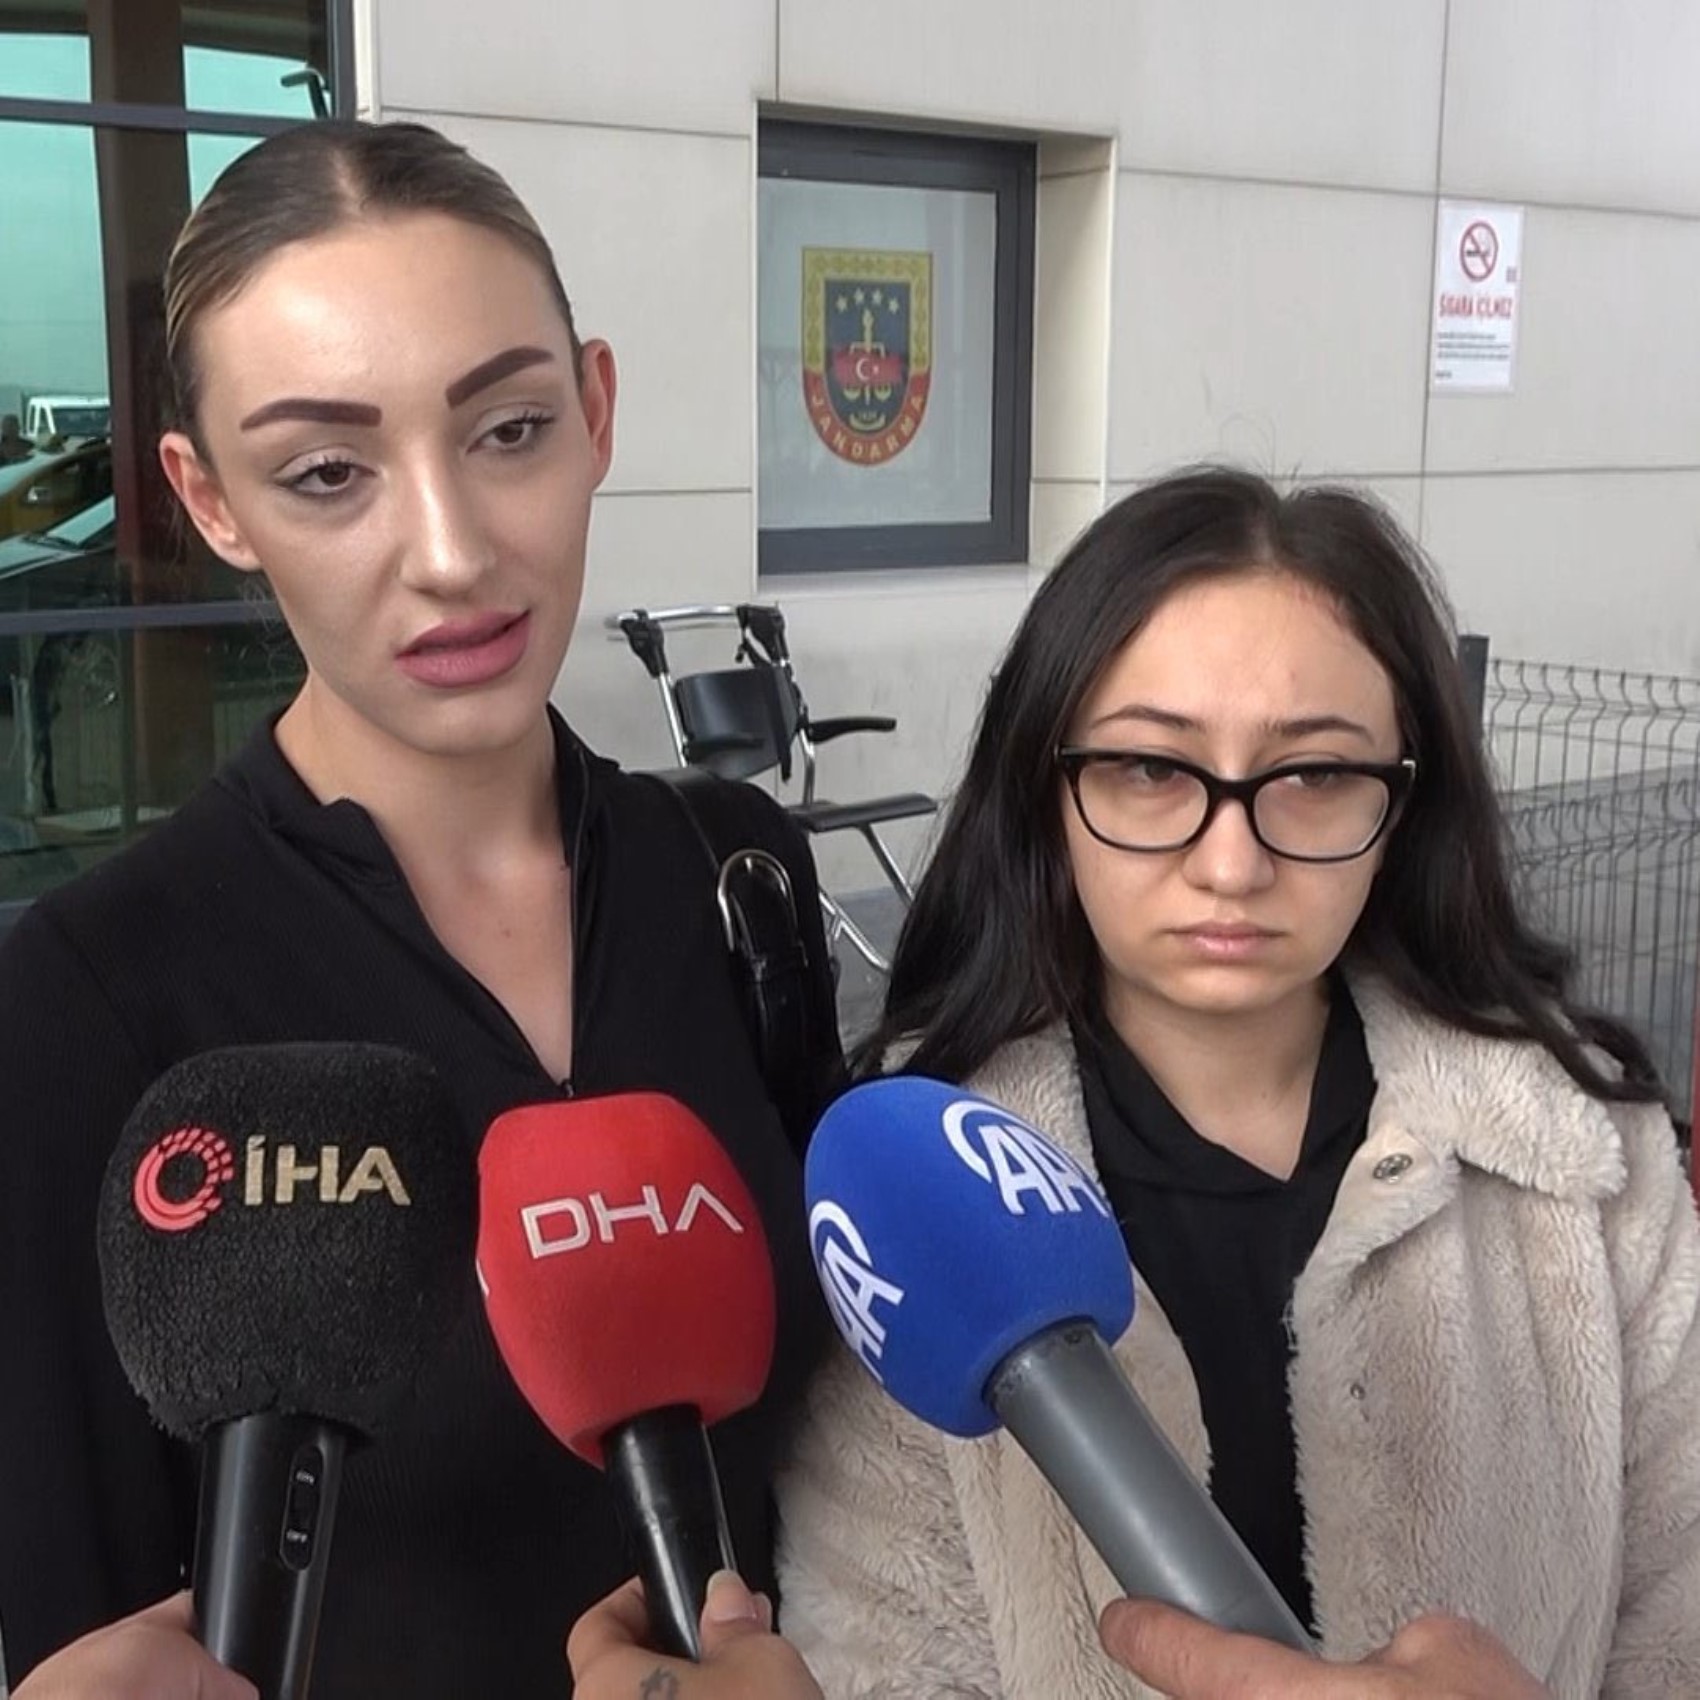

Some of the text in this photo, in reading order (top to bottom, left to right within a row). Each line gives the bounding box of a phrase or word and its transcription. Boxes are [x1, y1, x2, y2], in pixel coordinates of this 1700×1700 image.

[811, 394, 924, 462] JANDARMA
[245, 1134, 411, 1206] İHA
[521, 1182, 744, 1259] DHA
